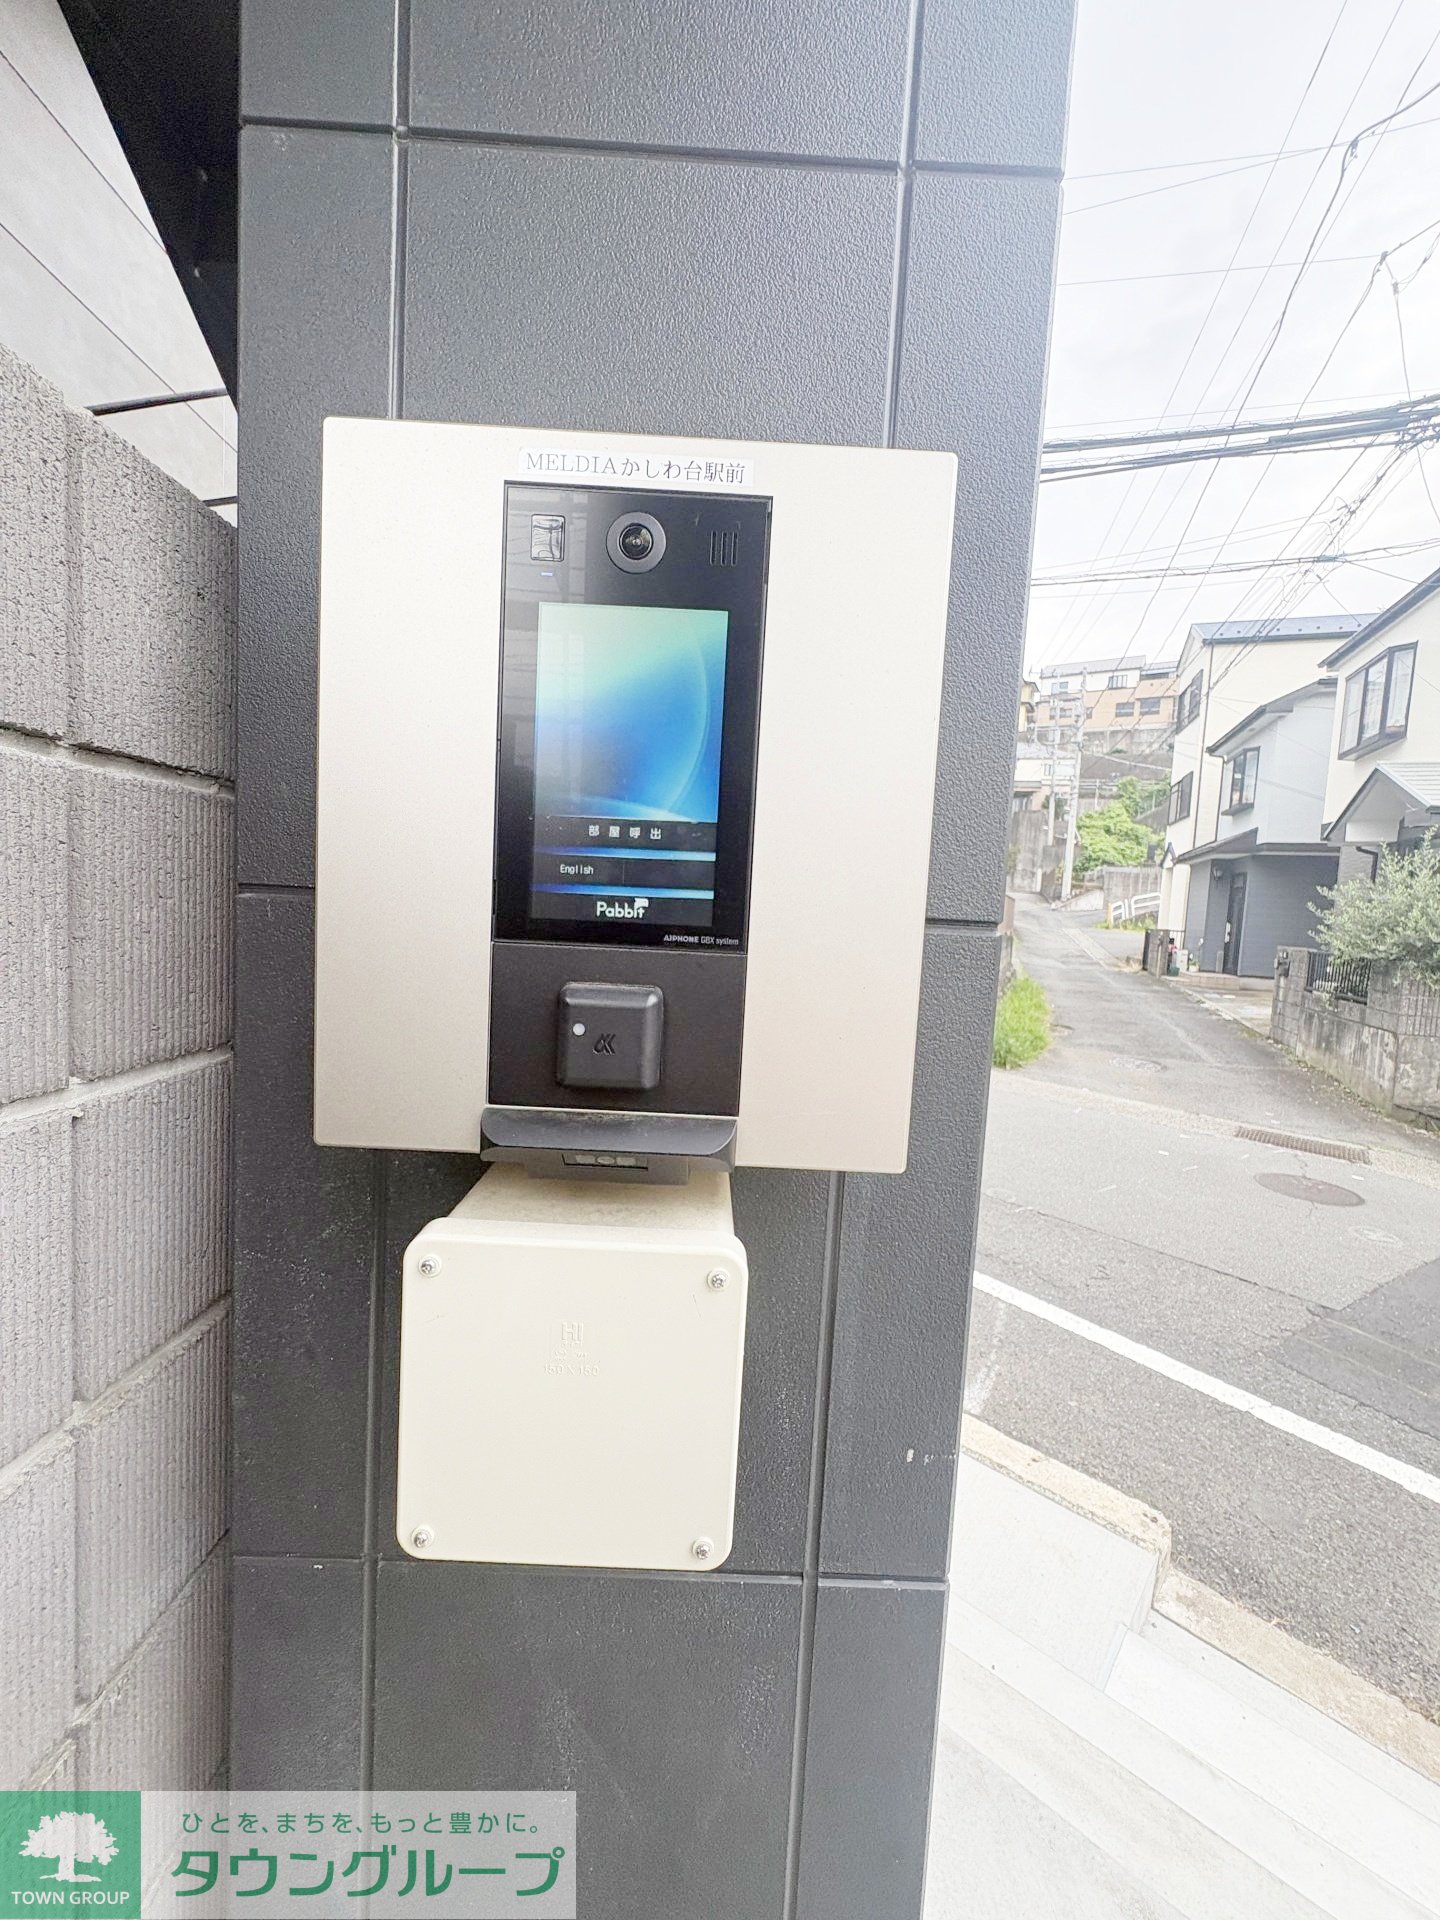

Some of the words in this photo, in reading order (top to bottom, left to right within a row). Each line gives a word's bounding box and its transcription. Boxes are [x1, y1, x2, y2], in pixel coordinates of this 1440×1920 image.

[526, 452, 746, 485] MELDIAかしわ台駅前
[588, 824, 662, 840] 部屋呼出
[560, 863, 594, 875] English
[596, 898, 649, 919] Pabbit
[663, 934, 699, 943] AIPHONE
[716, 937, 739, 946] system
